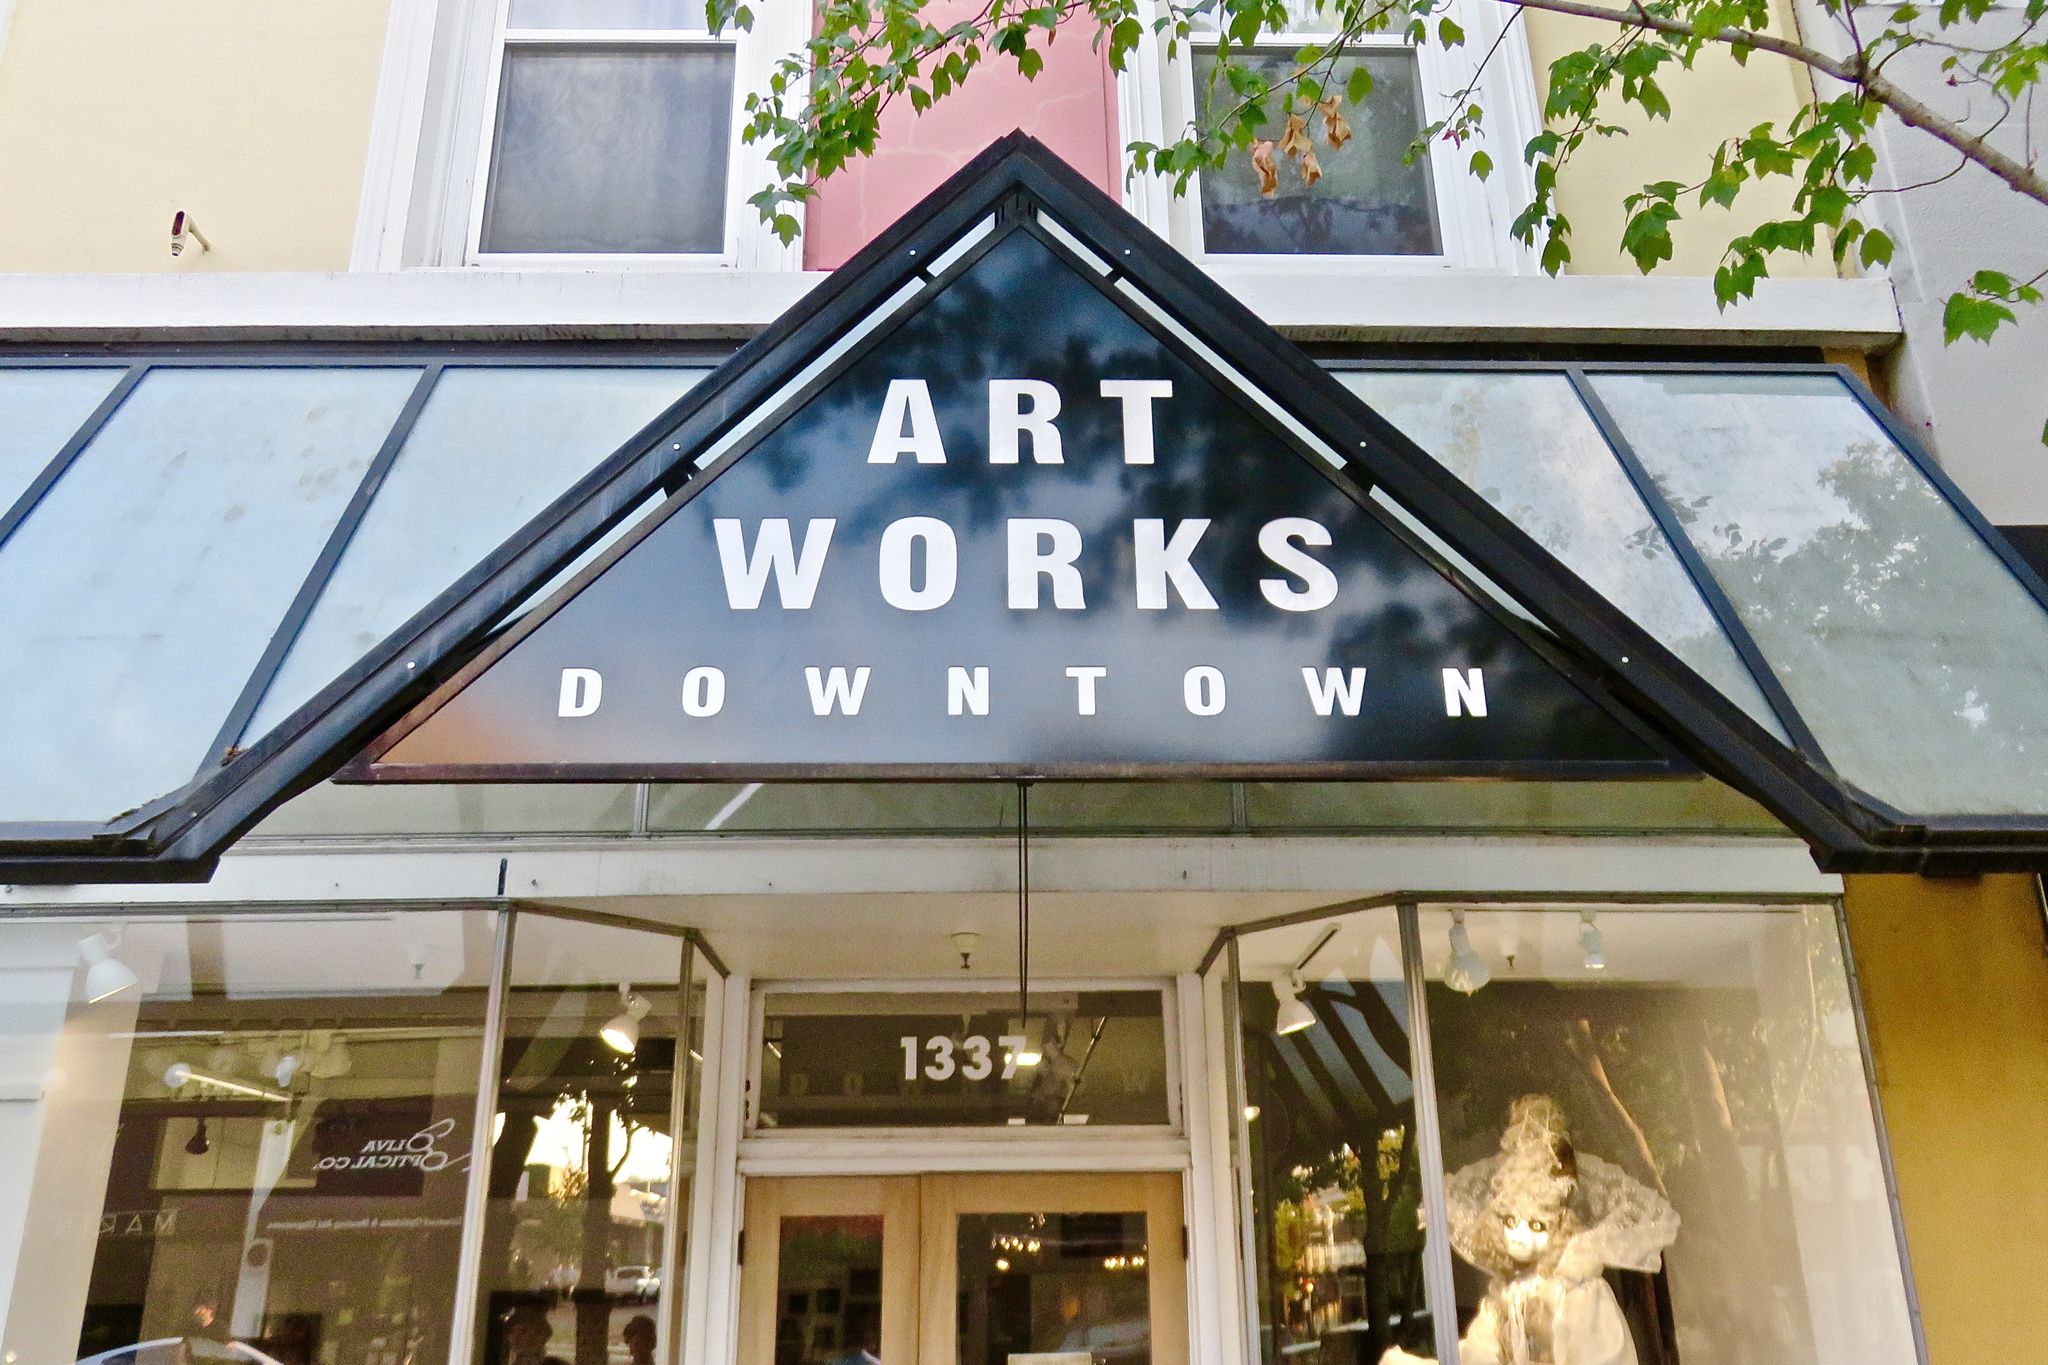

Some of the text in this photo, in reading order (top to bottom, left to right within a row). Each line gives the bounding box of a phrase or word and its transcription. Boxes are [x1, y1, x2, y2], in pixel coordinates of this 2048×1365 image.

[868, 379, 1173, 464] ART
[714, 517, 1338, 612] WORKS
[558, 666, 1487, 717] DOWNTOWN
[900, 1034, 1027, 1081] 1337
